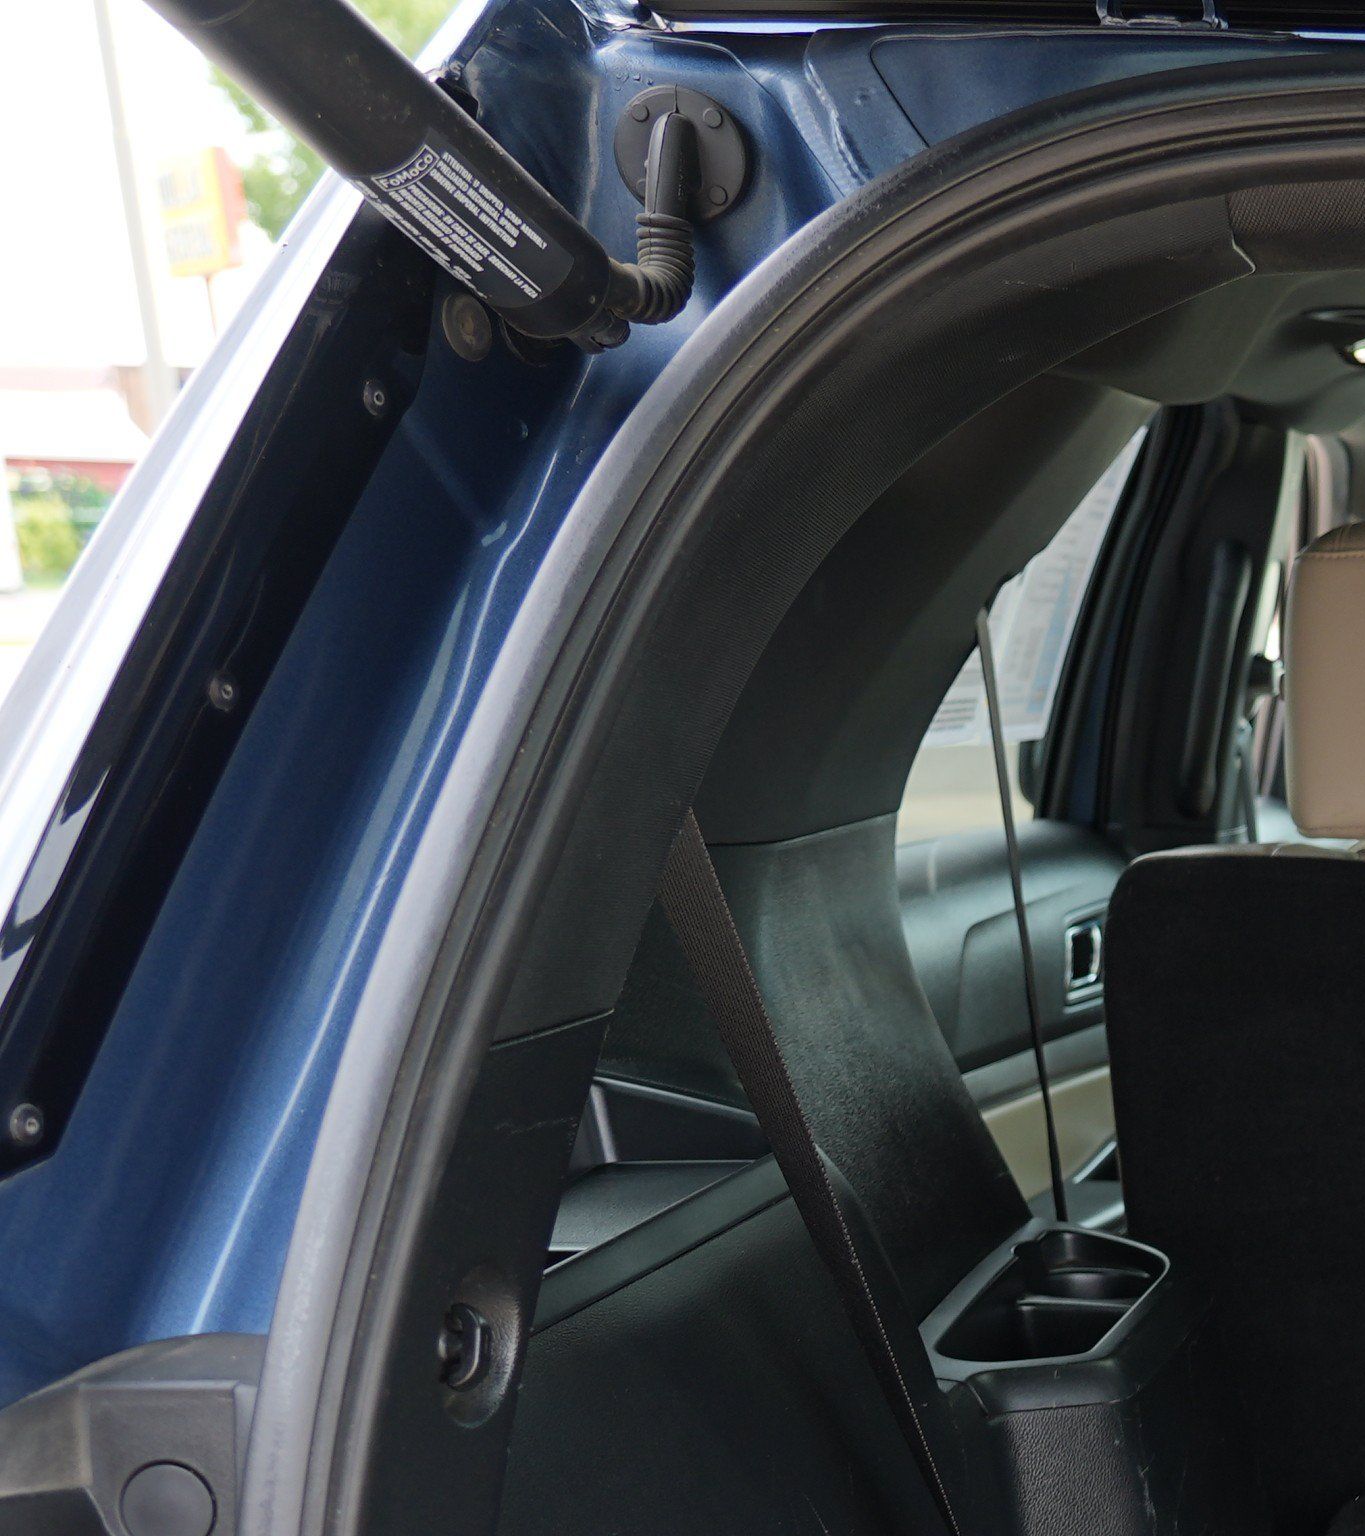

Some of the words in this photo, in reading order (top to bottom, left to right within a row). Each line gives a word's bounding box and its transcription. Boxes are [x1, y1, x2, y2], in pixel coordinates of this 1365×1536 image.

[380, 155, 433, 189] FoMoCo
[436, 160, 469, 192] PRELOADED
[466, 187, 500, 221] MECHANICAL
[429, 168, 456, 194] OBSERVE
[453, 189, 480, 216] DISPOSAL
[478, 212, 516, 247] INSTRUCTIONS
